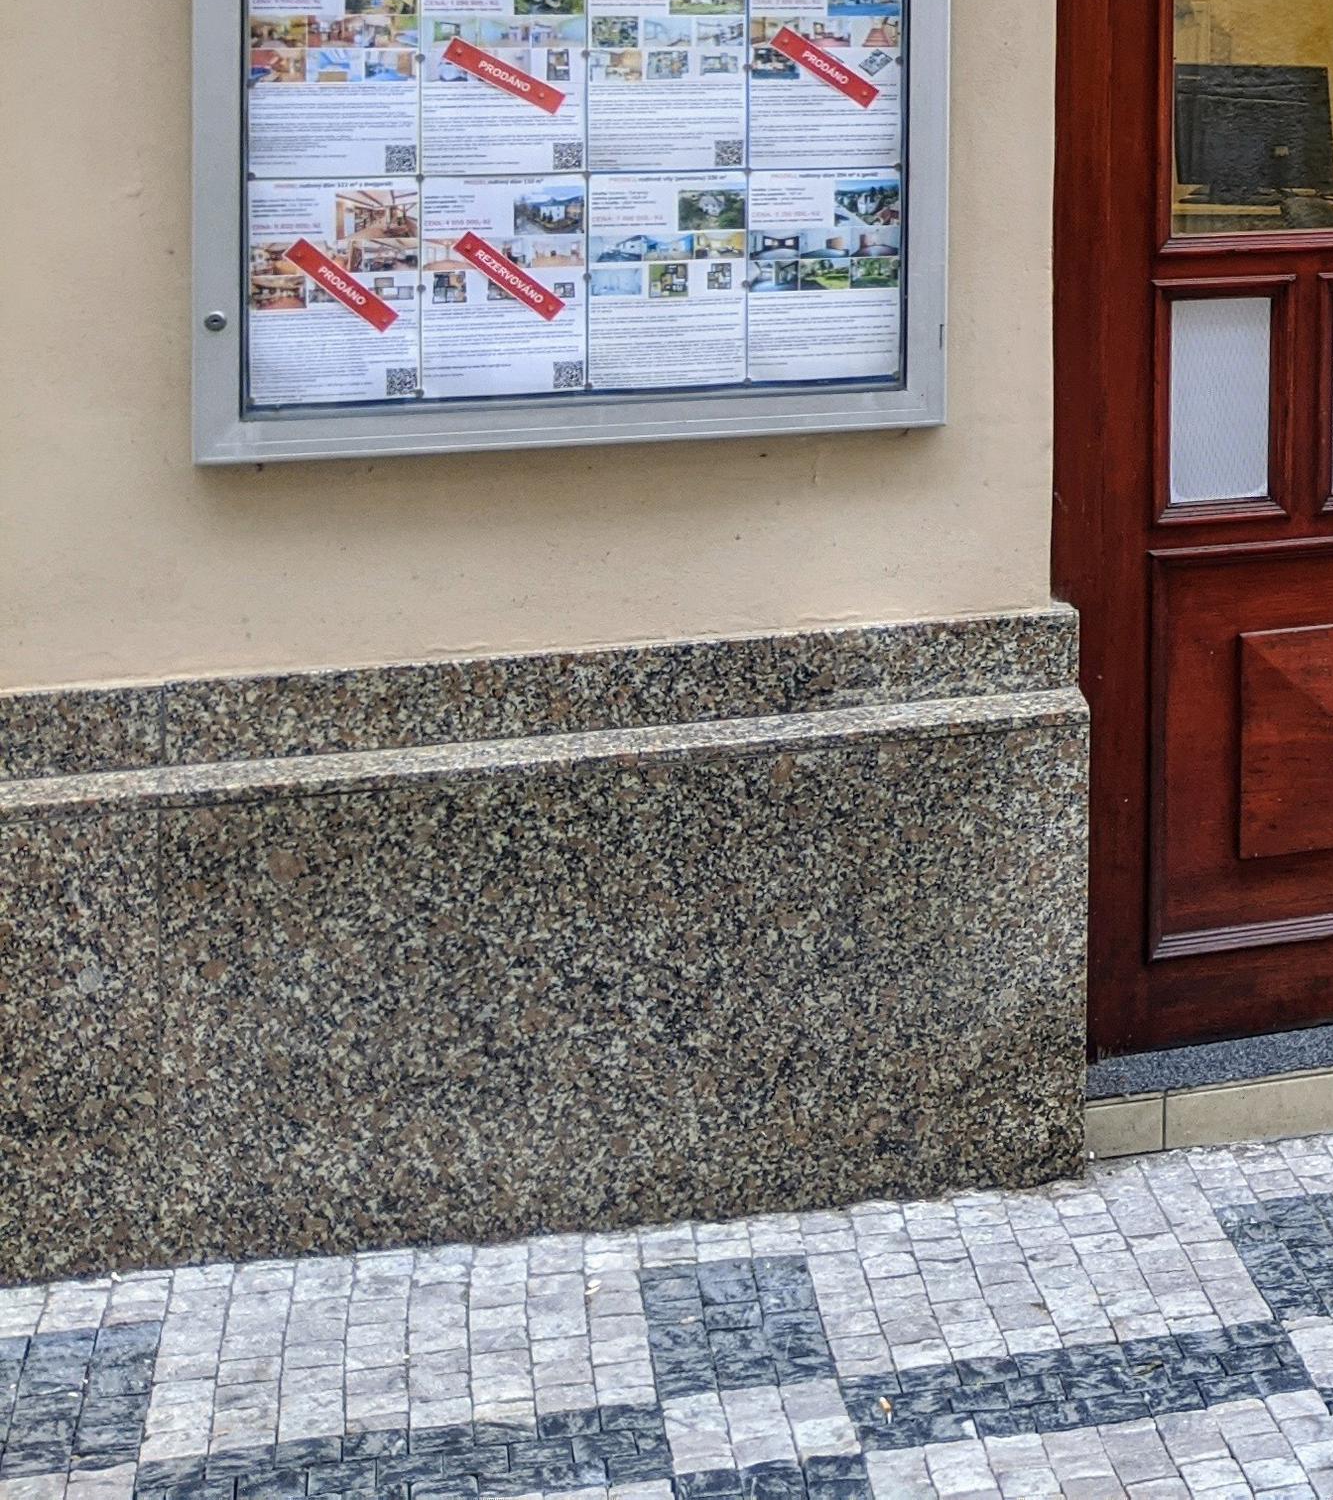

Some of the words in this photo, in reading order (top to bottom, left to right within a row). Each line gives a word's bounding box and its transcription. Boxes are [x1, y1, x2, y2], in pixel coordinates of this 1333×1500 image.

[478, 60, 531, 92] PRODÁNO
[802, 50, 849, 85] PRODÁNO
[318, 266, 366, 306] PRODÁNO
[475, 249, 544, 304] REZERVOVÁNO
